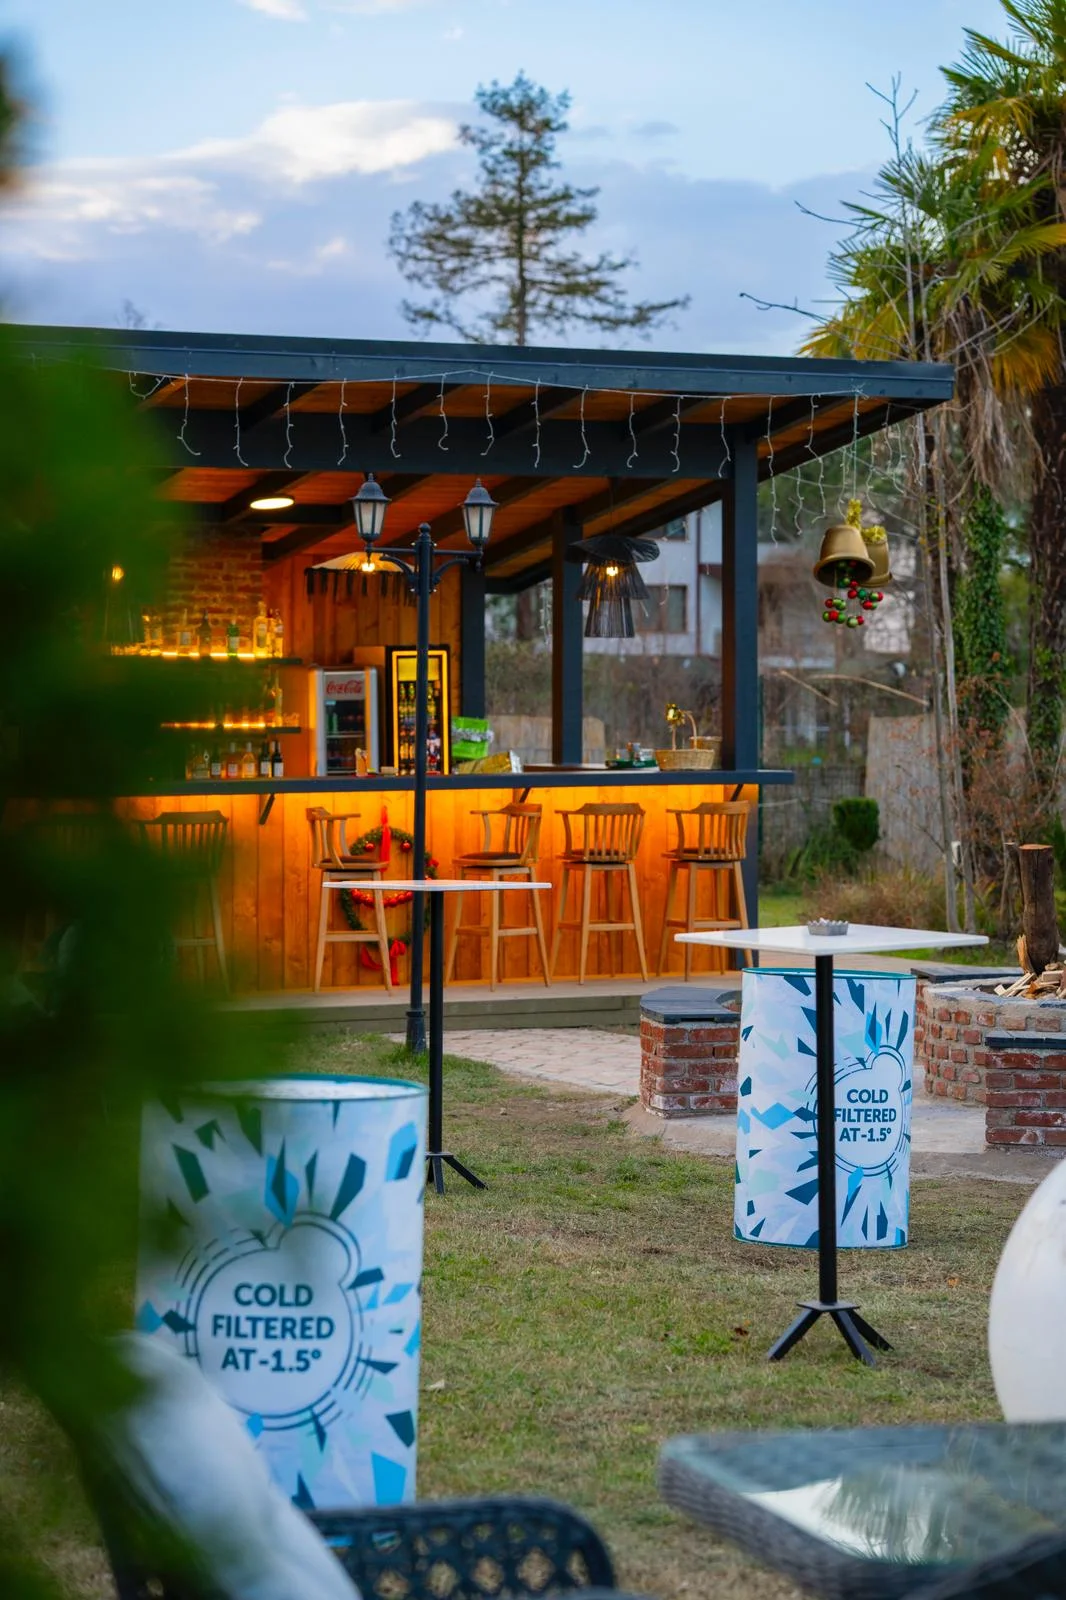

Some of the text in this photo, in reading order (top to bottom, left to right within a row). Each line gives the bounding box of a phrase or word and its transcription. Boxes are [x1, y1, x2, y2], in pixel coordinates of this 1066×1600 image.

[846, 1088, 889, 1104] COLD
[834, 1108, 897, 1123] FILTERED
[233, 1282, 314, 1308] COLD
[211, 1314, 336, 1340] FILTERED
